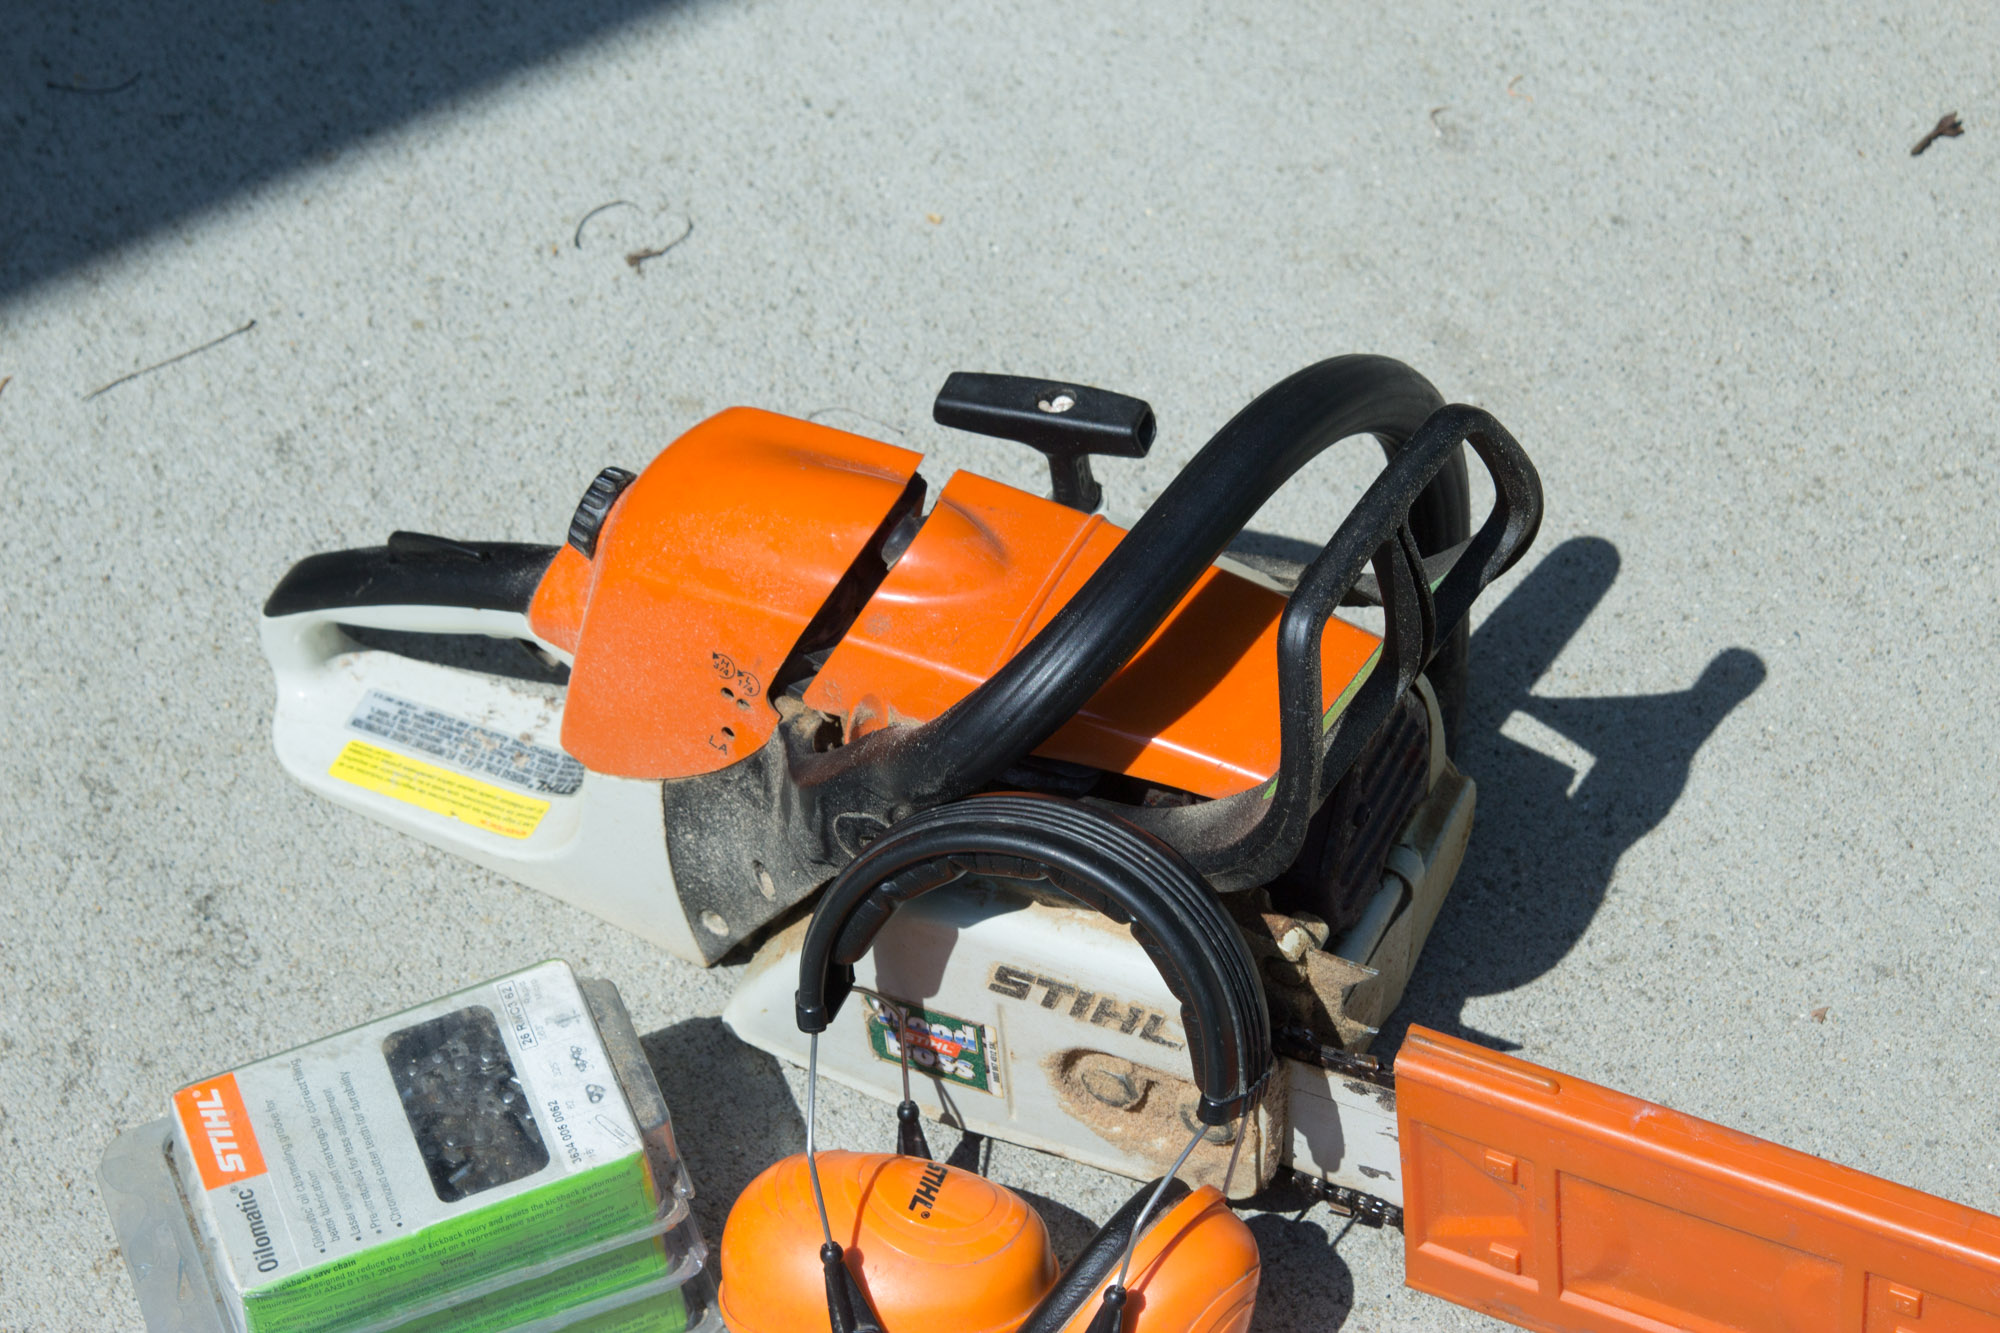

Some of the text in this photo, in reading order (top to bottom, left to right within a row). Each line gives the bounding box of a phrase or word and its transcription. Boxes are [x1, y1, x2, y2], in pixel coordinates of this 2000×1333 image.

[709, 735, 727, 755] LA
[501, 986, 515, 1000] 62
[988, 965, 1186, 1051] STIHL
[519, 1032, 533, 1045] 26
[902, 1030, 955, 1055] STIHL
[262, 1097, 277, 1112] for
[295, 1080, 317, 1115] correct
[197, 1088, 246, 1172] STIHL
[268, 1110, 290, 1143] groove
[307, 1114, 321, 1128] for
[547, 1099, 582, 1164] 3634 005 0062
[312, 1126, 339, 1169] markings
[320, 1086, 382, 1229] Pre-stretched for less adjustment
[335, 1069, 402, 1222] Chromized cutter teeth for durability
[279, 1142, 308, 1193] channeling
[909, 1162, 948, 1211] STIHL
[296, 1192, 310, 1206] oil
[304, 1168, 331, 1217] lubrication
[327, 1168, 355, 1211] engraved
[236, 1188, 279, 1273] Oilomatic
[308, 1272, 346, 1292] designed
[346, 1269, 355, 1277] to
[356, 1258, 385, 1274] reduce
[386, 1253, 400, 1264] the
[401, 1247, 416, 1259] risk
[417, 1244, 426, 1253] of
[427, 1230, 463, 1249] kickback
[464, 1222, 487, 1237] injury
[487, 1216, 503, 1227] and
[504, 1207, 529, 1221] meets
[530, 1201, 544, 1211] the
[544, 1188, 579, 1206] kickback
[343, 1211, 362, 1236] Laser
[323, 1281, 345, 1294] ANSI
[397, 1256, 420, 1269] when
[421, 1247, 447, 1261] tested
[447, 1243, 459, 1251] on
[466, 1218, 524, 1245] representative
[525, 1208, 554, 1224] sample
[554, 1203, 564, 1211] of
[438, 1248, 477, 1267] Warning!
[272, 1272, 311, 1293] kickback
[312, 1267, 331, 1279] saw
[332, 1257, 356, 1272] chain
[306, 1303, 332, 1319] should
